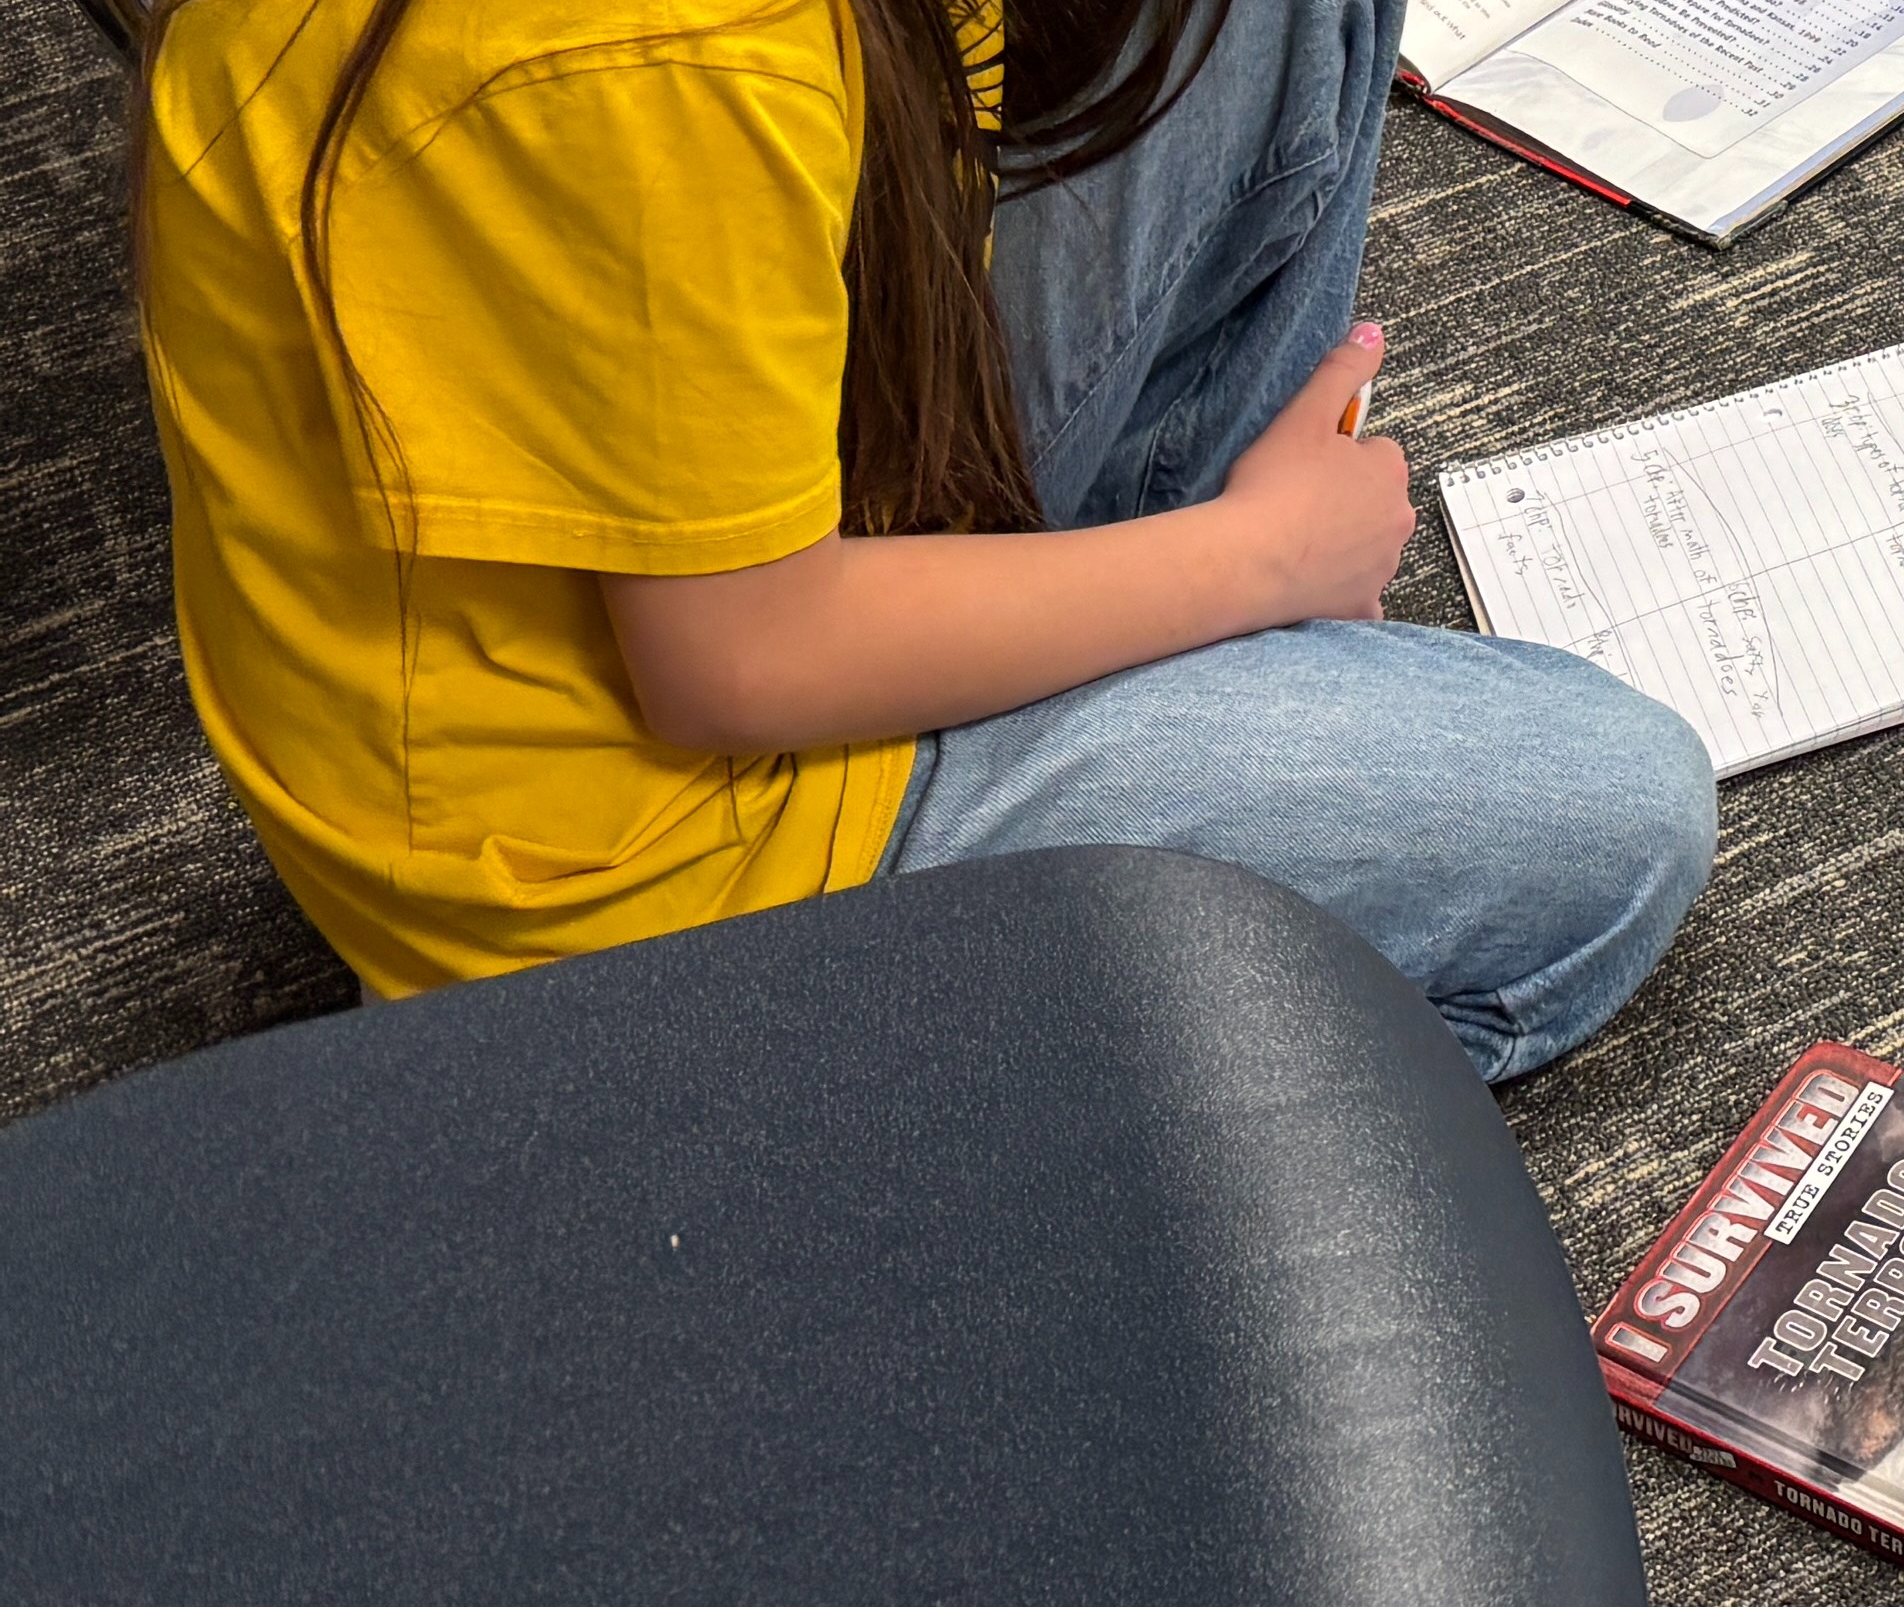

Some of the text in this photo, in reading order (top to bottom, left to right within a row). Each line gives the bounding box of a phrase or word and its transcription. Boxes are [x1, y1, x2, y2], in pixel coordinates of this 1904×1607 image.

[1611, 1072, 1862, 1365] I SURVIVED
[1775, 1090, 1884, 1235] TRUE STORIES
[1775, 1481, 1862, 1537] TORNADO
